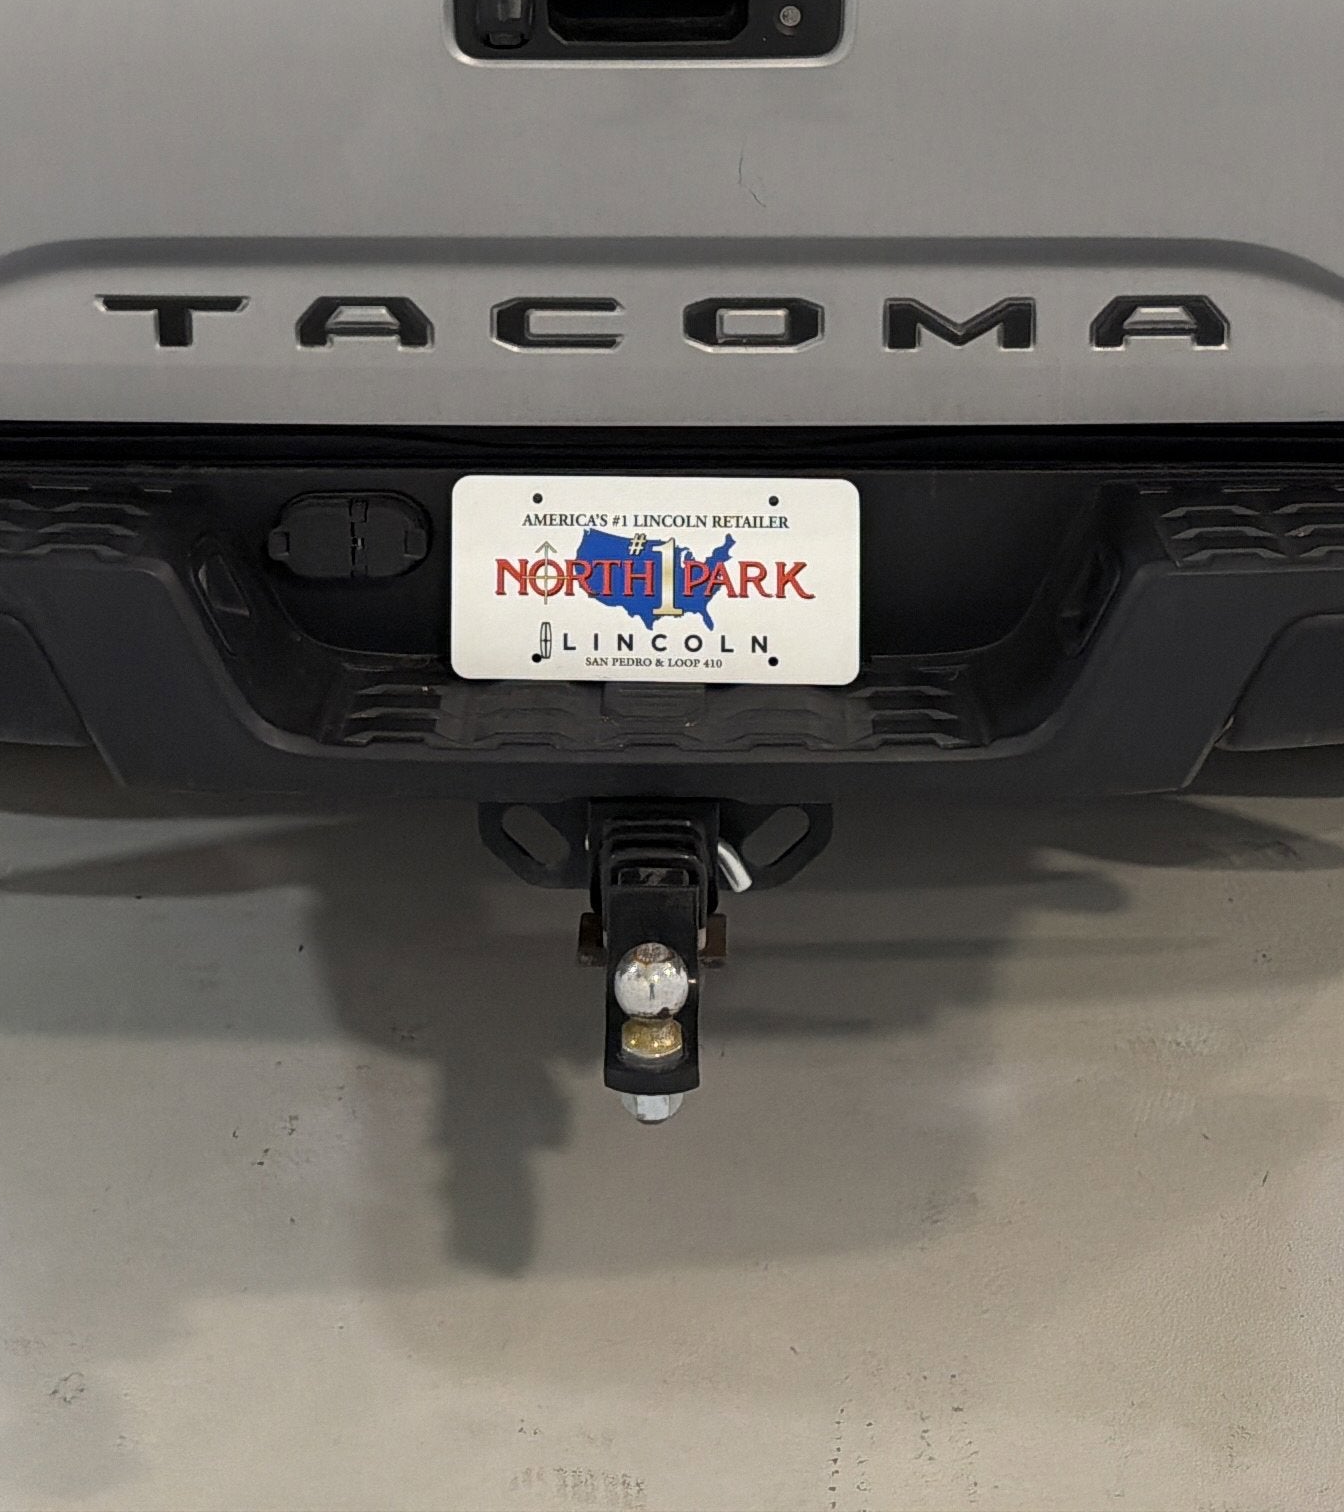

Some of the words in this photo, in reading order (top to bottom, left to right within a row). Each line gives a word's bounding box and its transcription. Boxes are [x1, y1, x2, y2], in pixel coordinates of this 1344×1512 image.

[94, 294, 1232, 352] TACOMA
[522, 513, 608, 527] AMERICA'S
[612, 514, 628, 527] #1
[633, 514, 707, 528] LINCOLN
[712, 515, 790, 529] RETAILER
[495, 558, 655, 597] NORTH
[682, 560, 816, 600] PARK
[562, 632, 768, 654] LINCOLN
[585, 656, 606, 667] SAN
[611, 657, 652, 667] PEDRO
[655, 658, 665, 668] &
[668, 658, 700, 668] LOOP
[703, 657, 723, 668] 410
